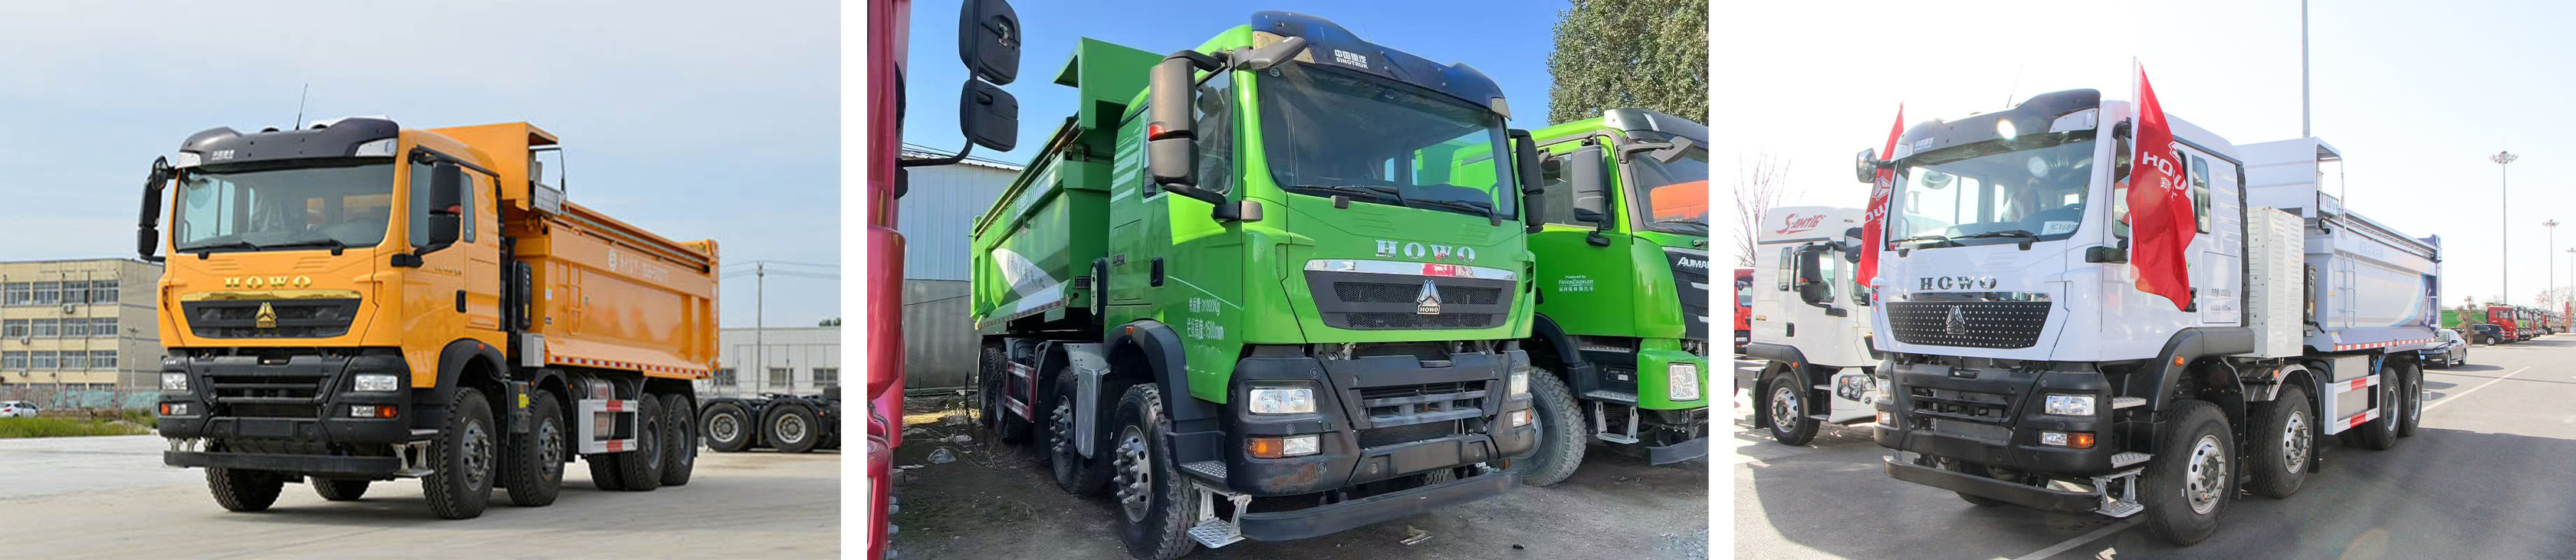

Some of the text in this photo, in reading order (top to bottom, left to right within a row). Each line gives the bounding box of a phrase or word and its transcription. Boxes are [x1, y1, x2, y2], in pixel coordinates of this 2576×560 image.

[1336, 57, 1368, 69] SINOTRUK
[2142, 151, 2191, 199] HOW
[1375, 239, 1476, 262] HOWO
[1677, 257, 1709, 268] AUMA
[224, 275, 312, 288] HOWO
[1920, 276, 1997, 290] HOWO
